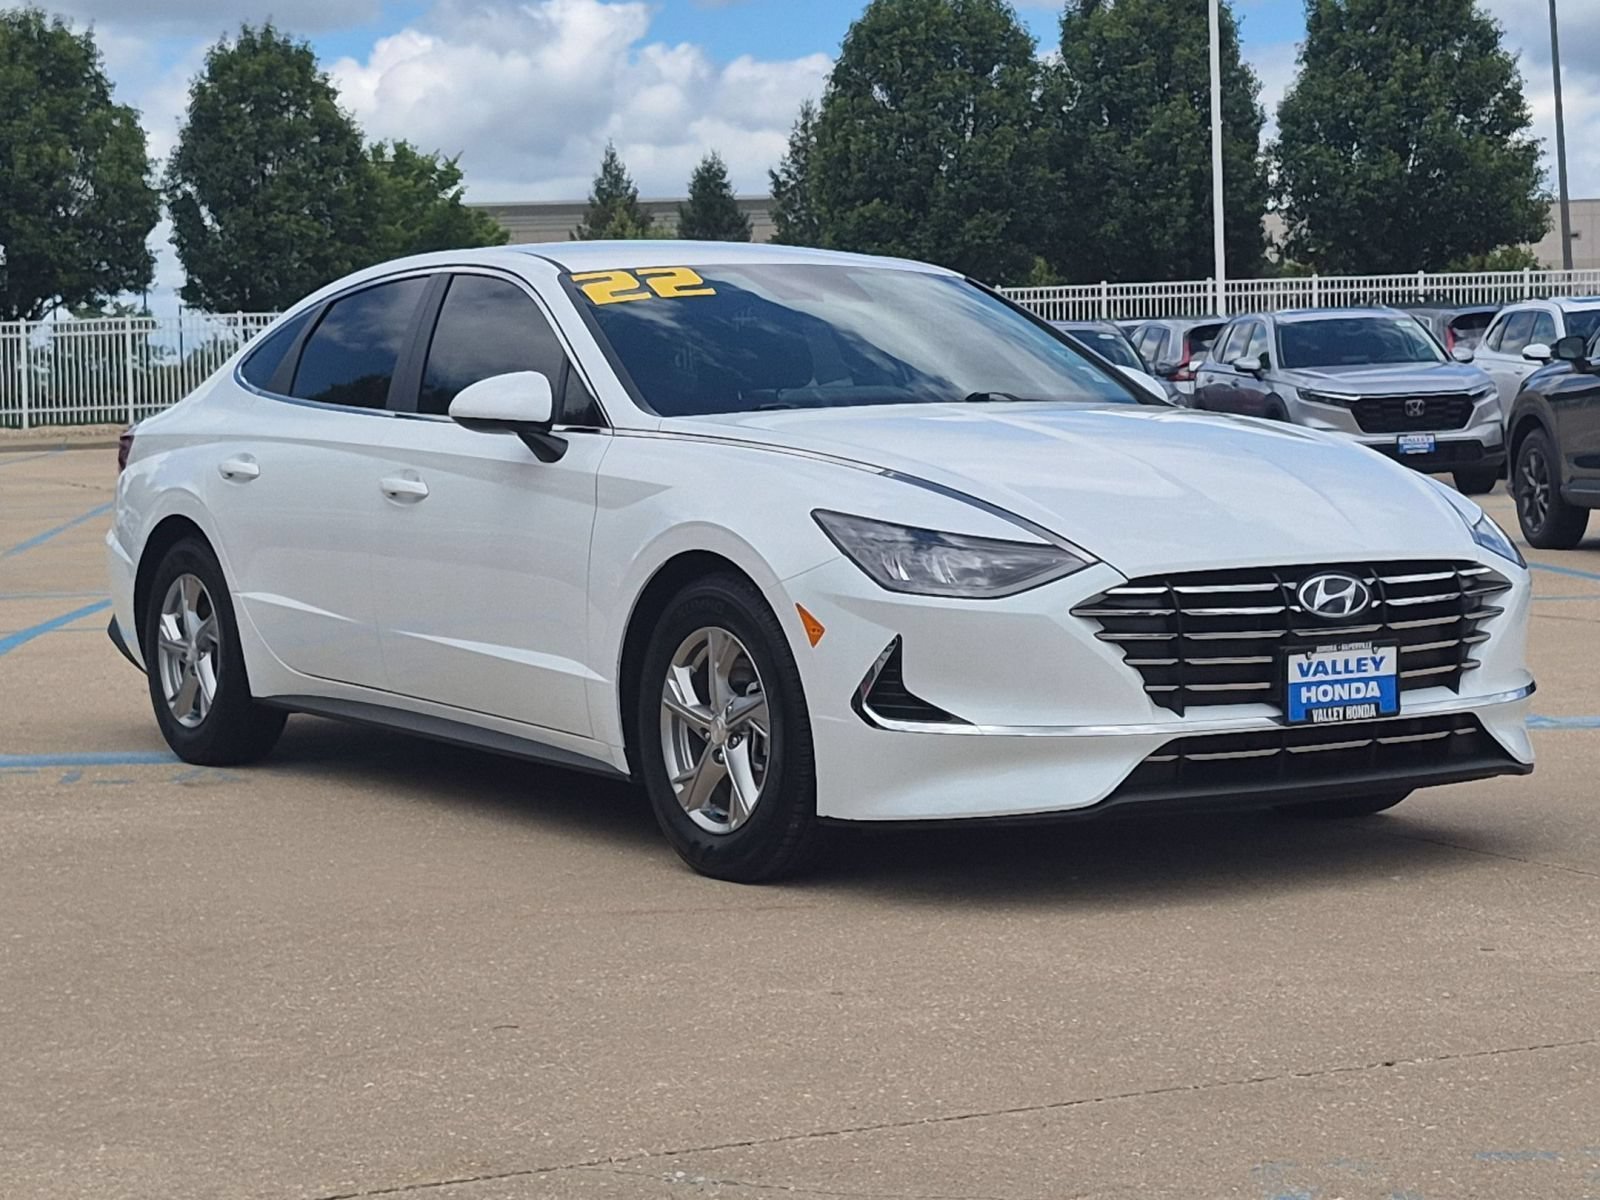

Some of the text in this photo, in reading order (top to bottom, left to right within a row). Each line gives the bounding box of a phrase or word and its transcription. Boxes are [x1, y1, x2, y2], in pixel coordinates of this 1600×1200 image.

[571, 267, 717, 305] 22
[1297, 656, 1386, 678] VALLEY
[1300, 681, 1381, 704] HONDA
[1312, 703, 1377, 723] VALLEY HONDA
